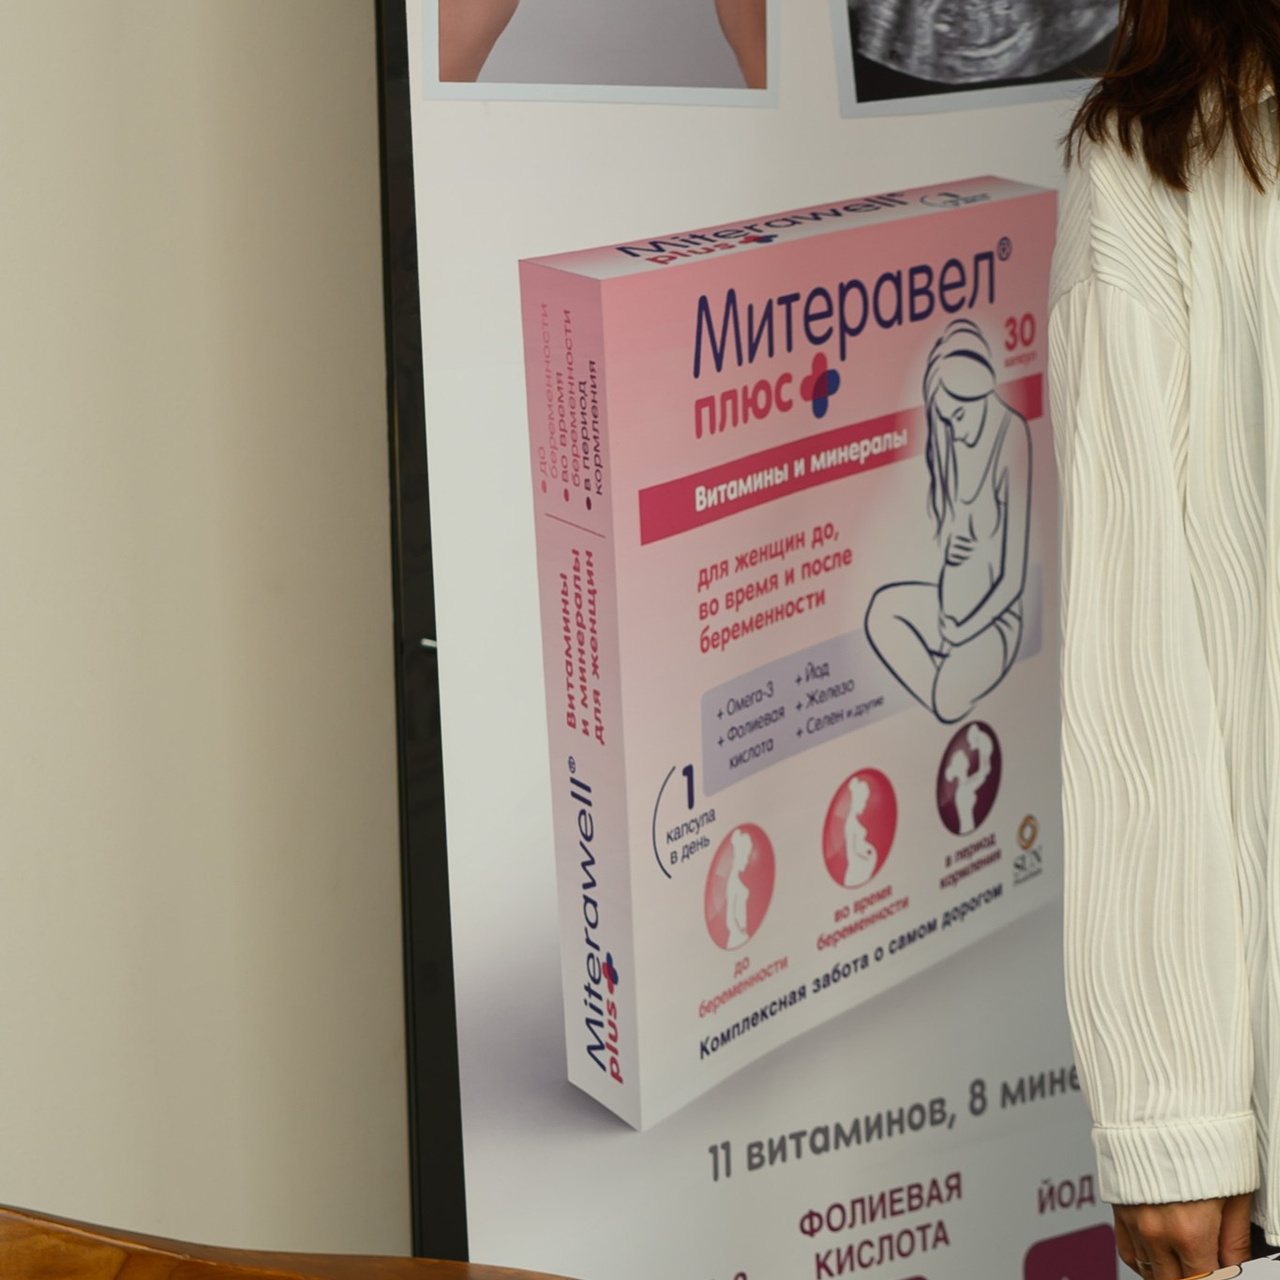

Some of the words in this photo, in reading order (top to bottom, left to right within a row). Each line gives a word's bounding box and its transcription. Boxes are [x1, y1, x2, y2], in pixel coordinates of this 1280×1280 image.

[646, 240, 736, 265] plus
[693, 236, 1012, 379] Митеравел®
[1004, 312, 1036, 352] 30
[556, 371, 567, 447] время
[563, 309, 581, 488] беременности
[578, 380, 592, 470] период
[588, 360, 603, 496] кормления
[694, 372, 793, 439] плюс
[560, 454, 569, 483] во
[584, 477, 592, 492] в
[695, 463, 788, 512] Витамины
[793, 458, 805, 478] и
[810, 429, 908, 473] минералы
[697, 559, 729, 592] для
[734, 531, 805, 573] женщин
[811, 522, 839, 549] до,
[699, 597, 719, 621] во
[725, 573, 779, 613] время
[785, 568, 794, 586] и
[801, 548, 853, 580] после
[571, 548, 588, 709] минералы
[585, 549, 600, 680] женщин
[700, 588, 826, 654] беременности
[559, 572, 576, 729] Витамины
[805, 662, 830, 683] Йод
[592, 689, 605, 746] для
[726, 680, 774, 716] Омега-3
[727, 706, 785, 742] Фолиевая
[805, 679, 855, 709] Железо
[581, 718, 590, 737] и
[729, 738, 774, 770] кислота
[682, 763, 695, 810] 1
[666, 808, 716, 844] капсула
[670, 850, 678, 865] в
[681, 836, 710, 862] день
[698, 956, 789, 1018] беременности
[700, 984, 807, 1060] Комплексная
[812, 950, 869, 994] забота
[874, 946, 884, 962] о
[888, 917, 938, 955] самом
[941, 883, 1003, 930] дорогом
[733, 957, 750, 978] до
[605, 998, 624, 1085] plus
[708, 1138, 733, 1182] 11
[746, 1095, 957, 1172] витаминов,
[968, 1078, 988, 1117] 8
[1000, 1062, 1081, 1109] мине
[798, 1172, 963, 1239] ФОЛИЕВАЯ
[1037, 1172, 1095, 1215] ЙОД
[815, 1219, 951, 1280] КИСЛОТА
